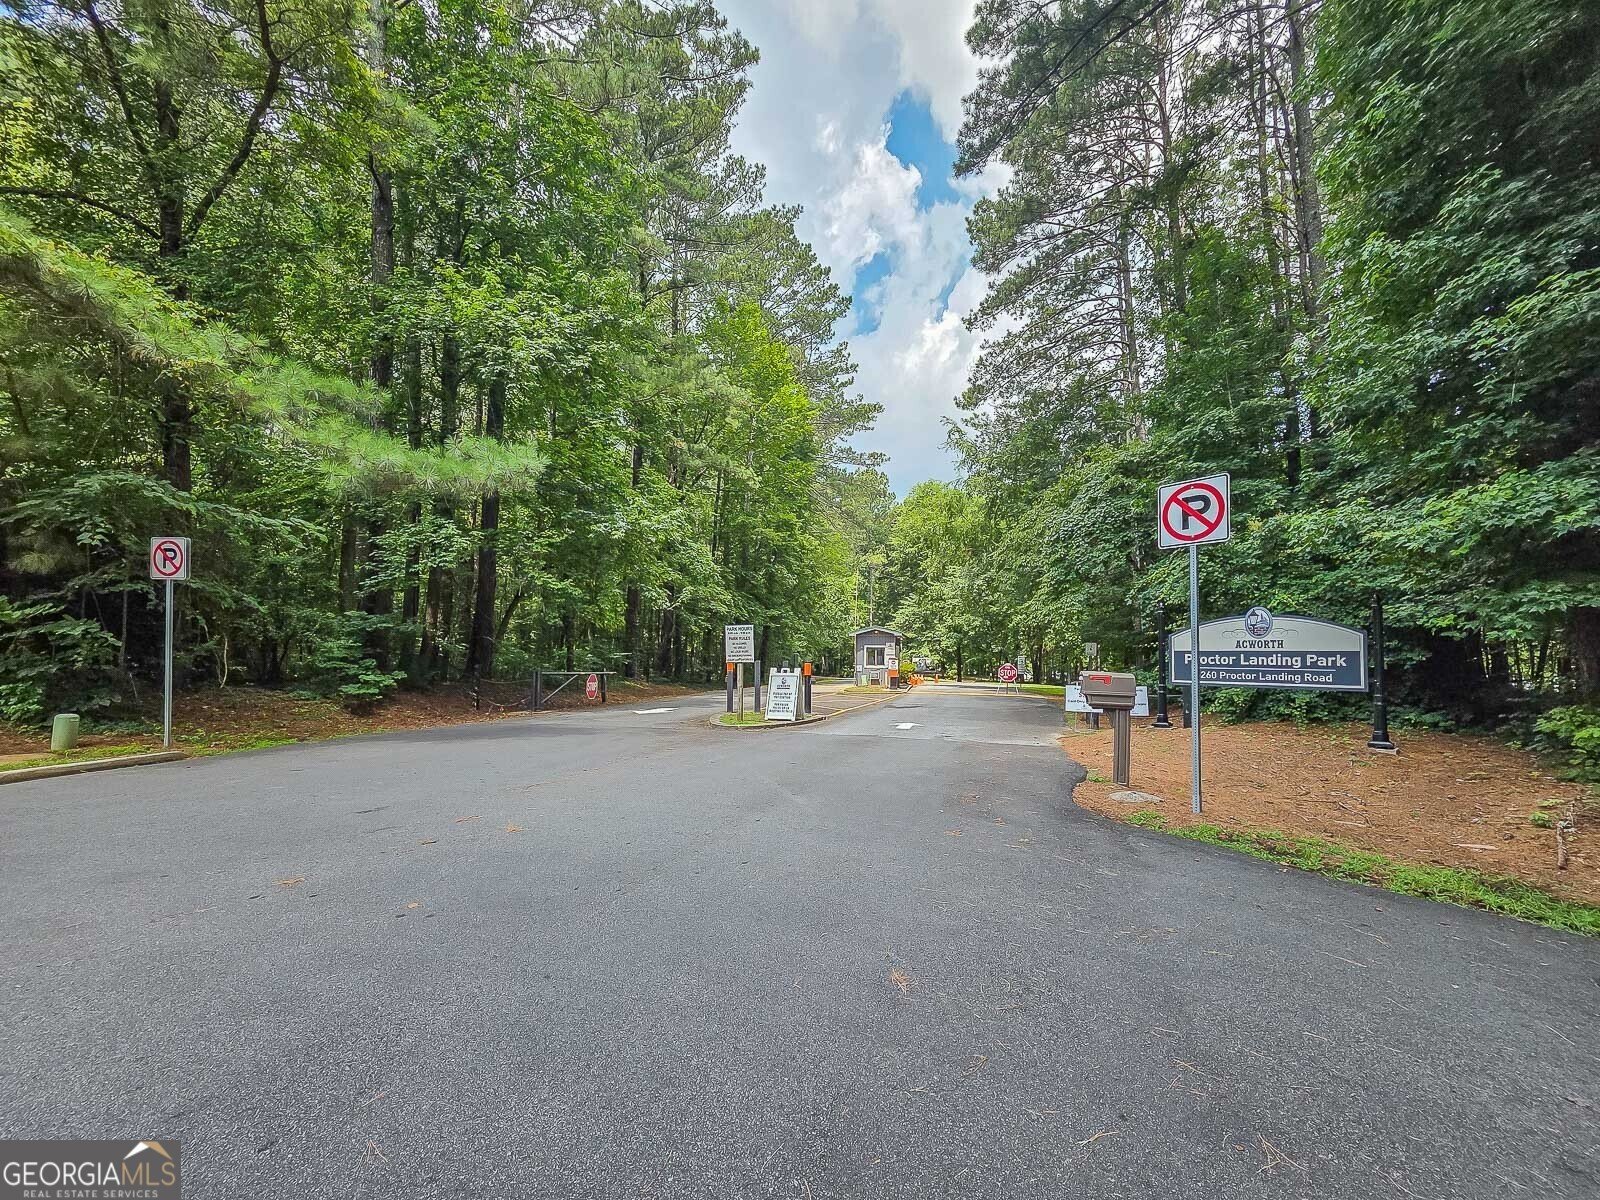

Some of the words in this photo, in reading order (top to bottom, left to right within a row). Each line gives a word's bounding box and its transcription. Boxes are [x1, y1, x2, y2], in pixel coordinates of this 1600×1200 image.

[1235, 639, 1284, 649] ACWORTH
[1184, 653, 1236, 665] Poctor
[1240, 653, 1301, 668] Landing
[1306, 654, 1347, 667] Park
[1000, 669, 1016, 677] STOP
[1219, 671, 1256, 681] Proctor
[1259, 672, 1301, 683] Landing
[1304, 673, 1333, 683] Road
[586, 682, 598, 691] STOP
